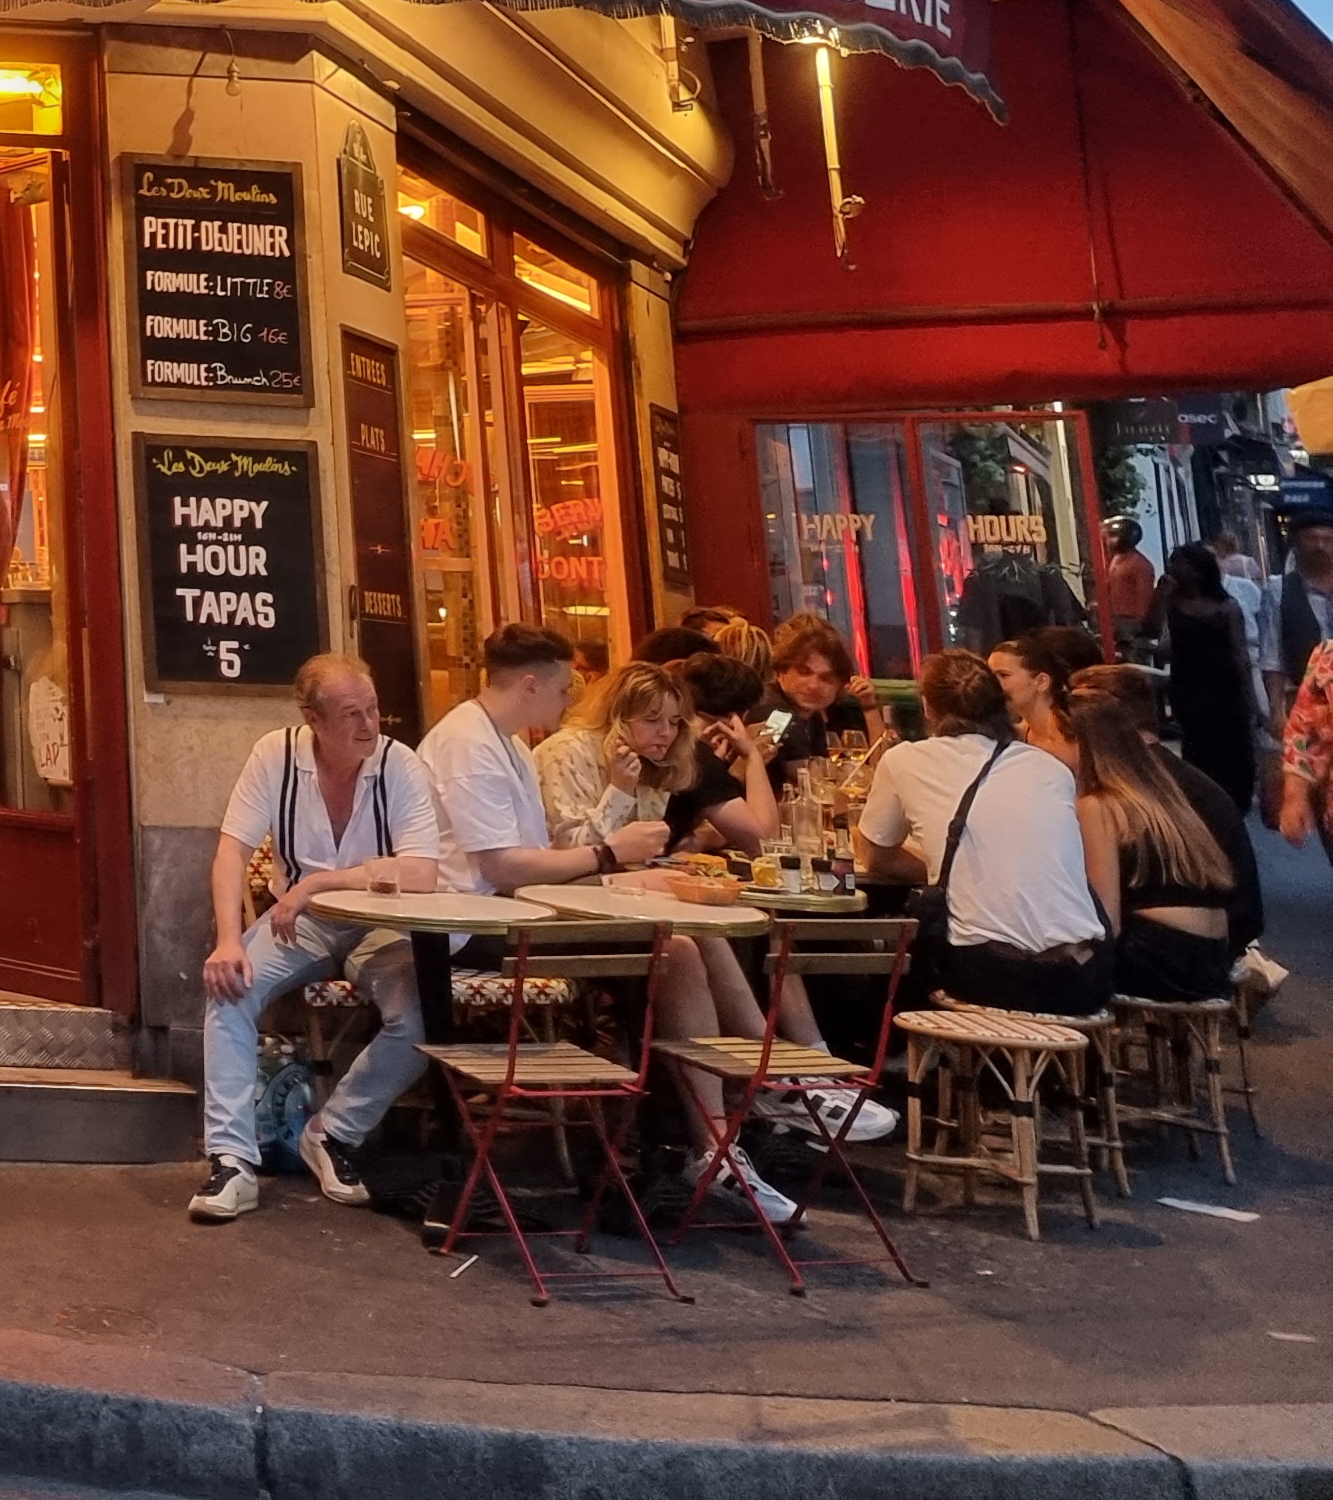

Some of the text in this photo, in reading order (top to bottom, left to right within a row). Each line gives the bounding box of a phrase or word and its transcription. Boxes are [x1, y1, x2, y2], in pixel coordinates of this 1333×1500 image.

[138, 171, 167, 197] Les
[210, 179, 278, 204] Moulins
[353, 188, 374, 223] RUE
[351, 221, 382, 259] LEPIC
[146, 270, 215, 295] FORMULE:
[216, 275, 274, 298] LITTLE
[146, 315, 215, 341] FORMULE:
[212, 318, 254, 343] BIG
[146, 359, 215, 387] FORMULE:
[269, 369, 302, 388] 25€
[350, 352, 387, 387] ENTREES
[360, 422, 386, 454] PLATS
[156, 448, 186, 476] Les
[173, 496, 269, 529] HAPPY
[801, 514, 876, 541] HAPPY
[966, 514, 1048, 543] HOURS
[179, 543, 269, 577] HOUR
[175, 587, 276, 629] TAPAS
[364, 590, 403, 618] DESSERTS
